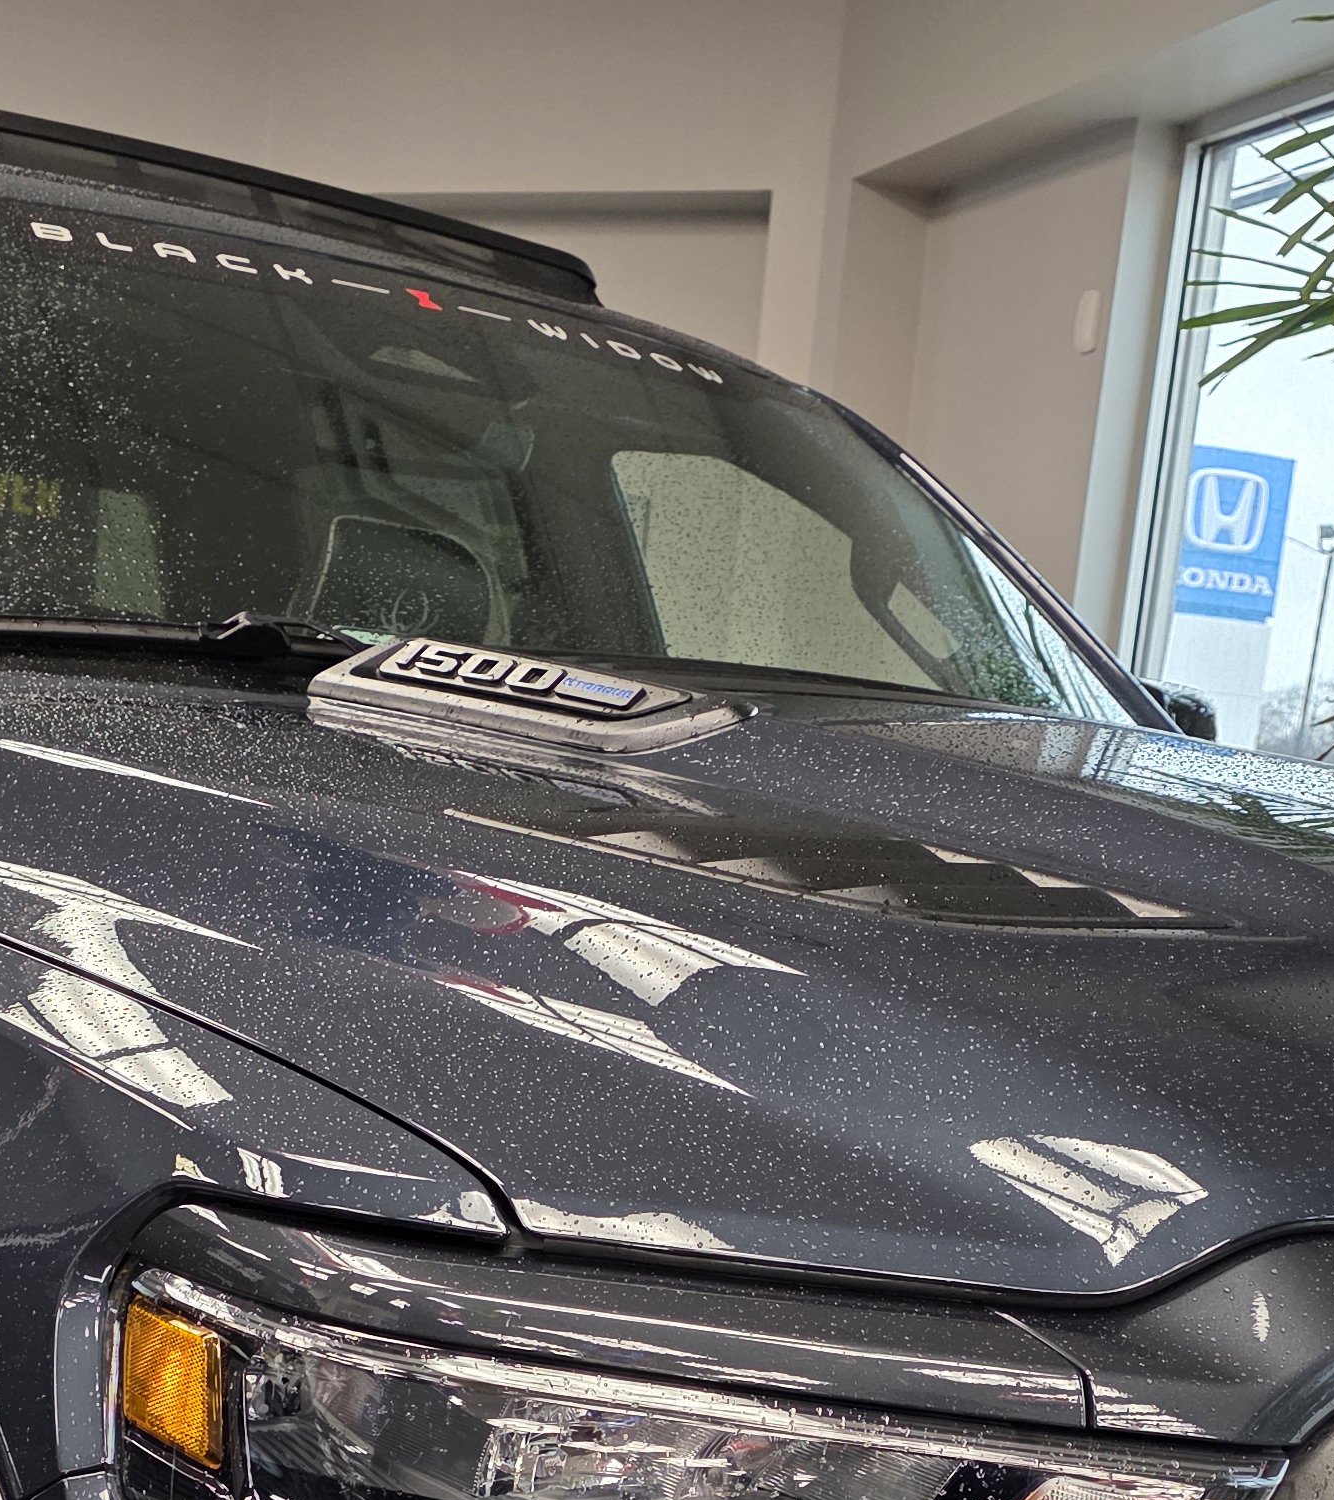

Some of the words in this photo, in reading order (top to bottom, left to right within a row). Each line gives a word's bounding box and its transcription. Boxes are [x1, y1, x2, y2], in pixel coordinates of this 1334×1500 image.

[30, 221, 314, 285] BLACK
[527, 318, 724, 384] WIDOW
[1177, 565, 1274, 597] ONDA
[397, 638, 566, 694] 1500
